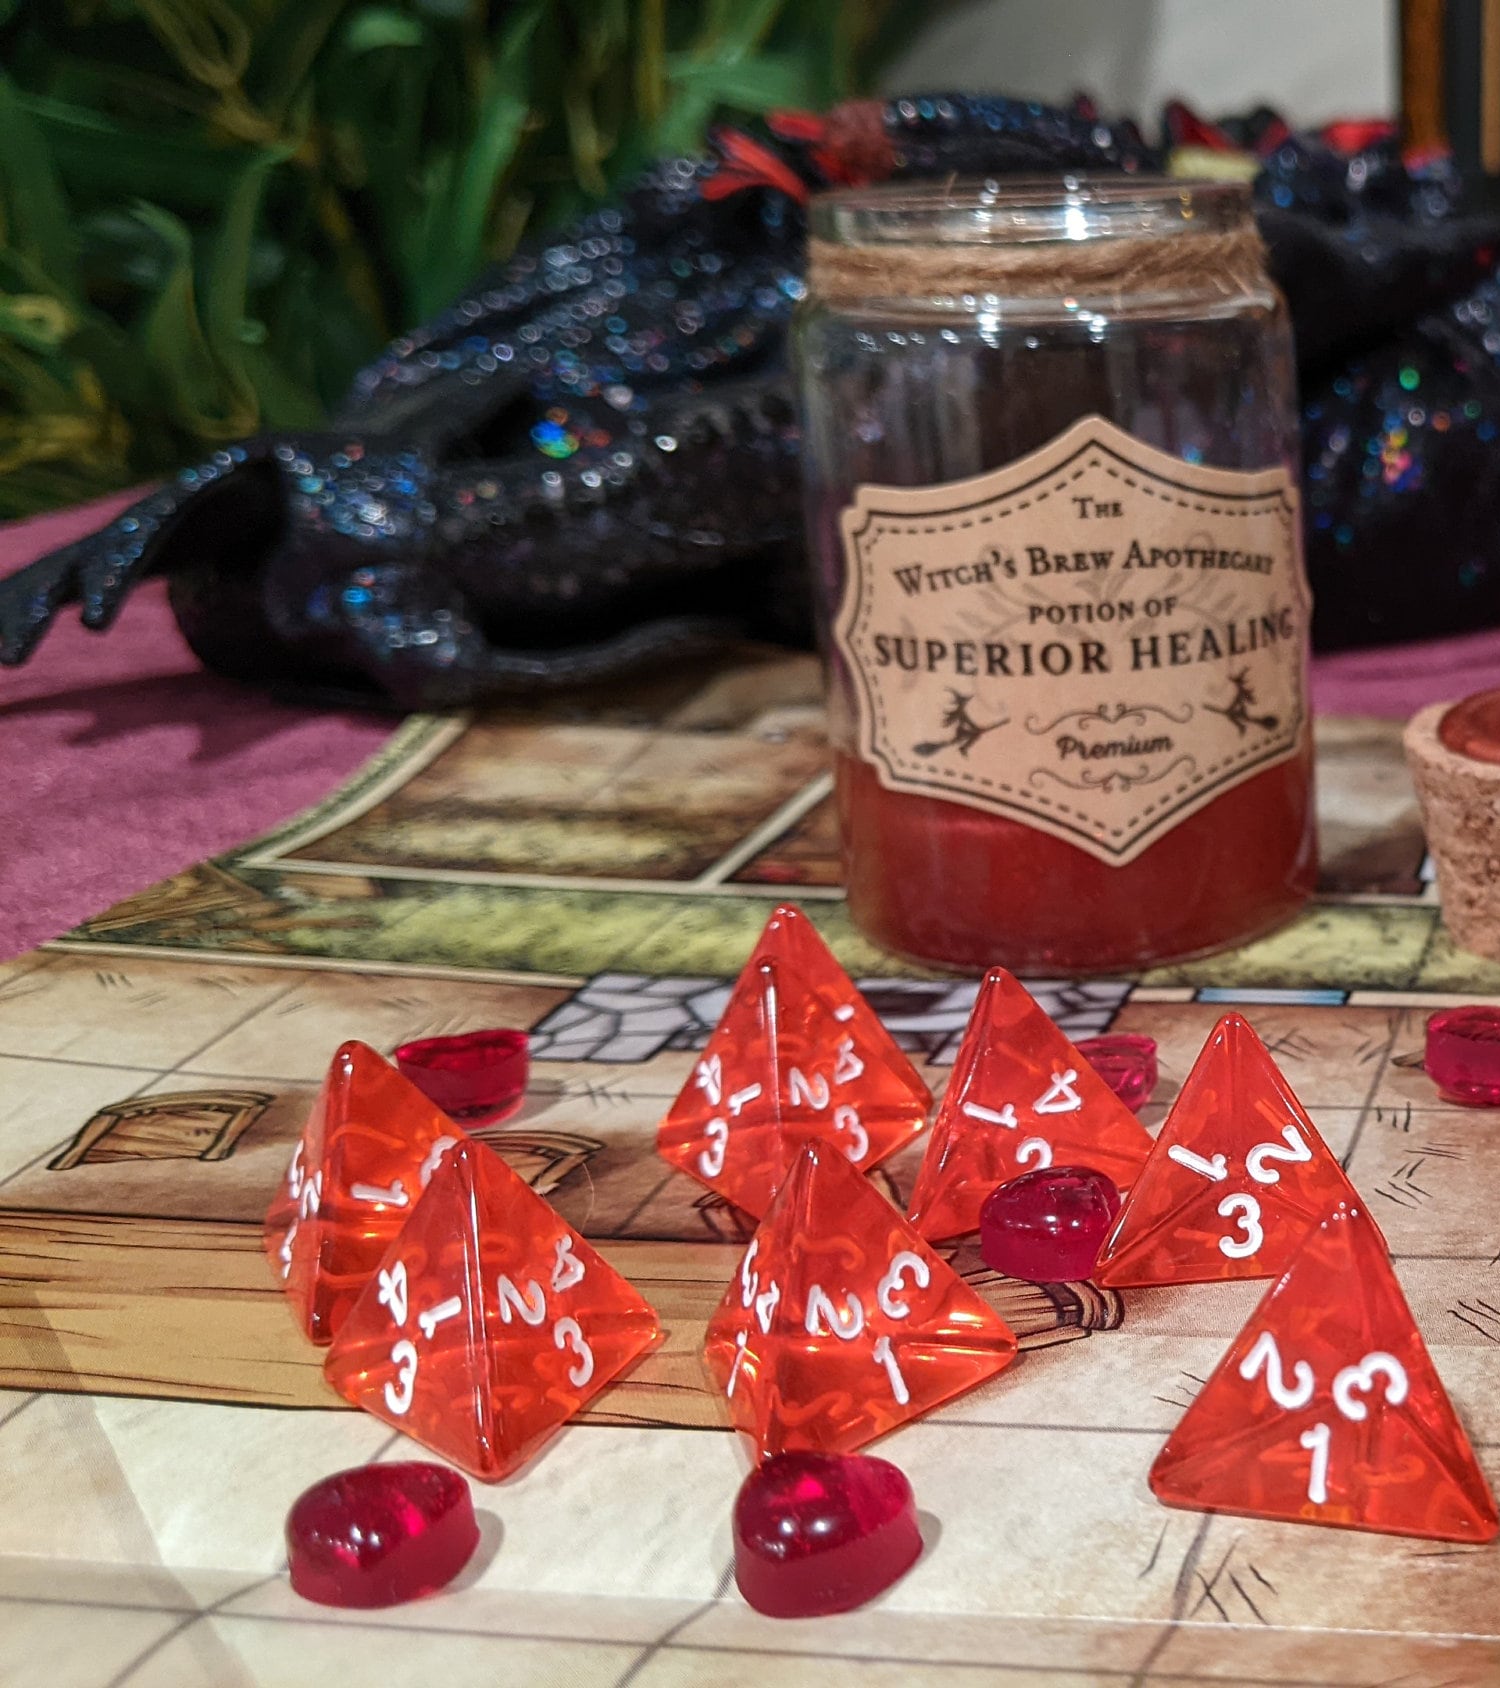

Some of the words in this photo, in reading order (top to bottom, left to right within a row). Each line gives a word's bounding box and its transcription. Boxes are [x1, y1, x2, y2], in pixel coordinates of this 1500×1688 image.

[1026, 547, 1113, 577] BREW
[1028, 602, 1134, 625] POTION
[1144, 596, 1177, 620] OF
[873, 633, 1111, 677] SUPERIOR
[1130, 607, 1295, 672] HEALING
[1055, 732, 1175, 762] Premium
[789, 1067, 831, 1110] 2
[962, 1101, 1018, 1129] 1
[1032, 1068, 1083, 1115] 4
[699, 1116, 729, 1178] 3
[1167, 1144, 1229, 1182] 1
[1245, 1124, 1314, 1185] 2
[351, 1179, 409, 1212] 1
[1216, 1192, 1264, 1260] 3
[552, 1234, 586, 1293] 4
[876, 1250, 931, 1320] 3
[378, 1260, 409, 1328] 4
[418, 1295, 463, 1340] 1
[497, 1274, 546, 1326] 2
[804, 1283, 865, 1341] 2
[382, 1339, 418, 1417] 3
[554, 1316, 595, 1388] 3
[873, 1335, 910, 1406] 1
[1238, 1330, 1317, 1411] 2
[1331, 1350, 1410, 1422] 3
[1299, 1422, 1332, 1505] 1
